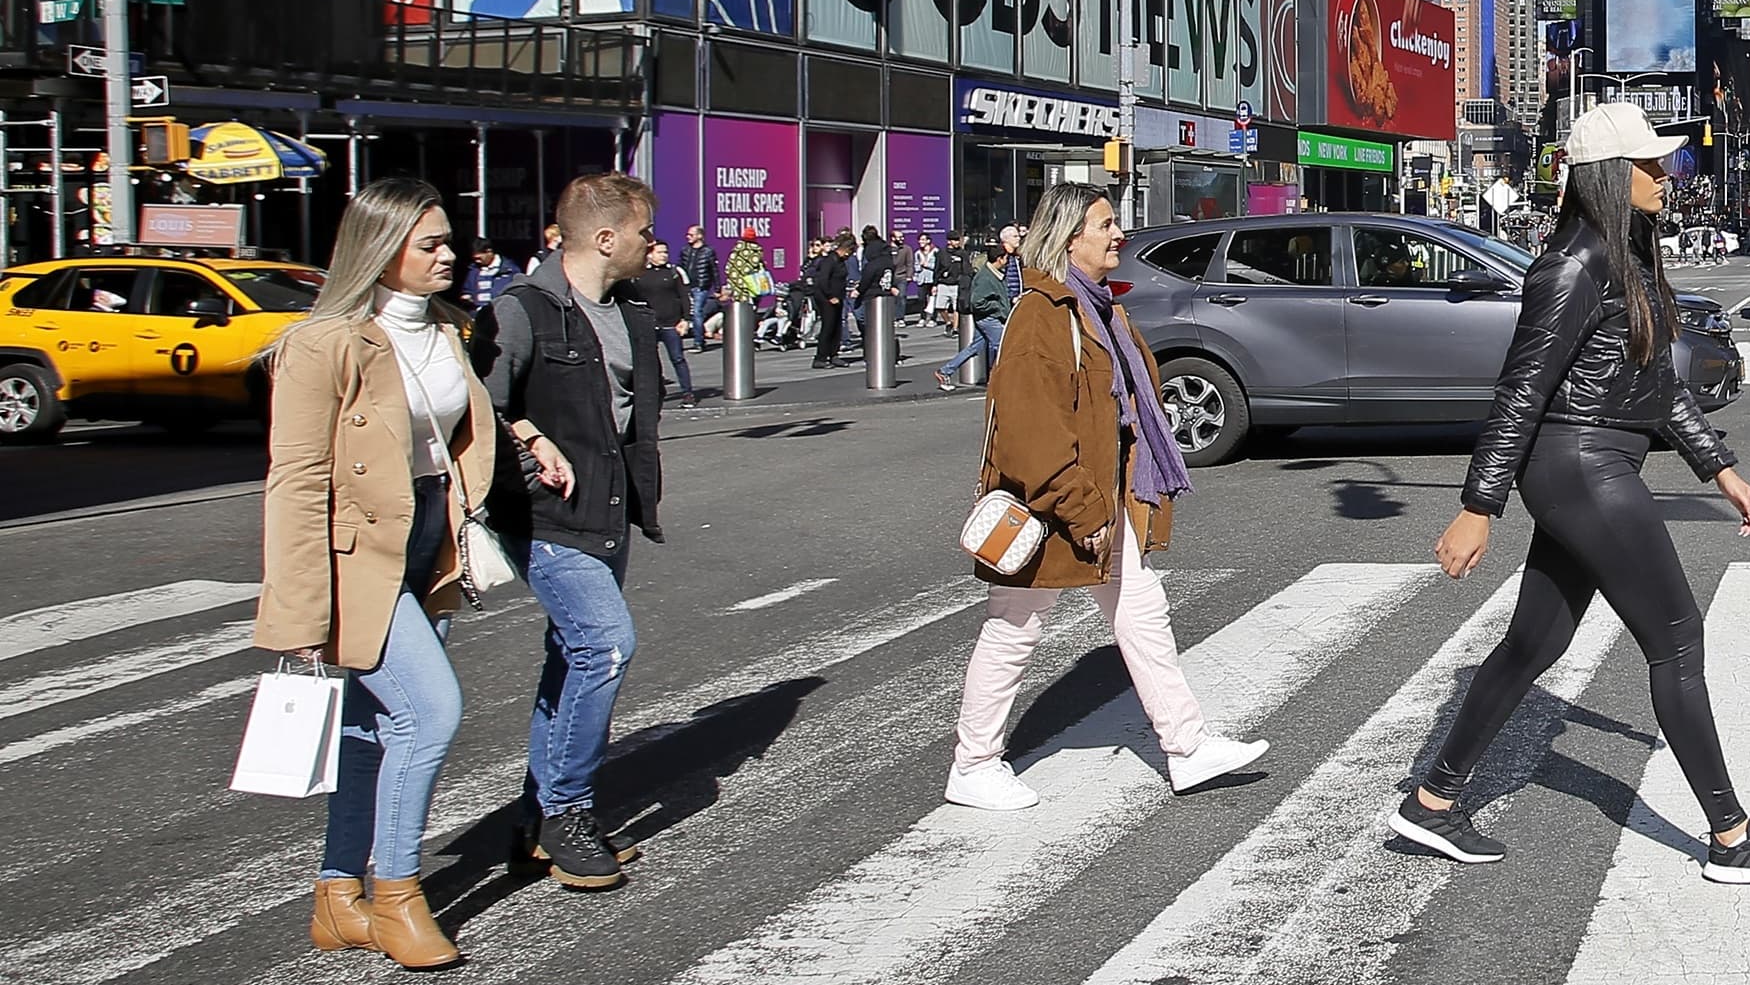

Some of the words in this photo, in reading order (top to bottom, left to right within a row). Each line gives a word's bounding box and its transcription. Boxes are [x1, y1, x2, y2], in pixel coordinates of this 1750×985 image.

[1390, 20, 1451, 69] Chickenjoy
[963, 87, 1120, 137] SKECHERS
[1317, 142, 1332, 158] NEW
[1332, 144, 1348, 160] YORK
[195, 165, 274, 179] SABRETT
[717, 167, 768, 188] FLAGSHIP
[717, 192, 752, 213] RETAIL
[753, 193, 785, 213] SPACE
[149, 219, 193, 232] LOUIS
[717, 218, 737, 238] FOR
[175, 348, 195, 372] T
